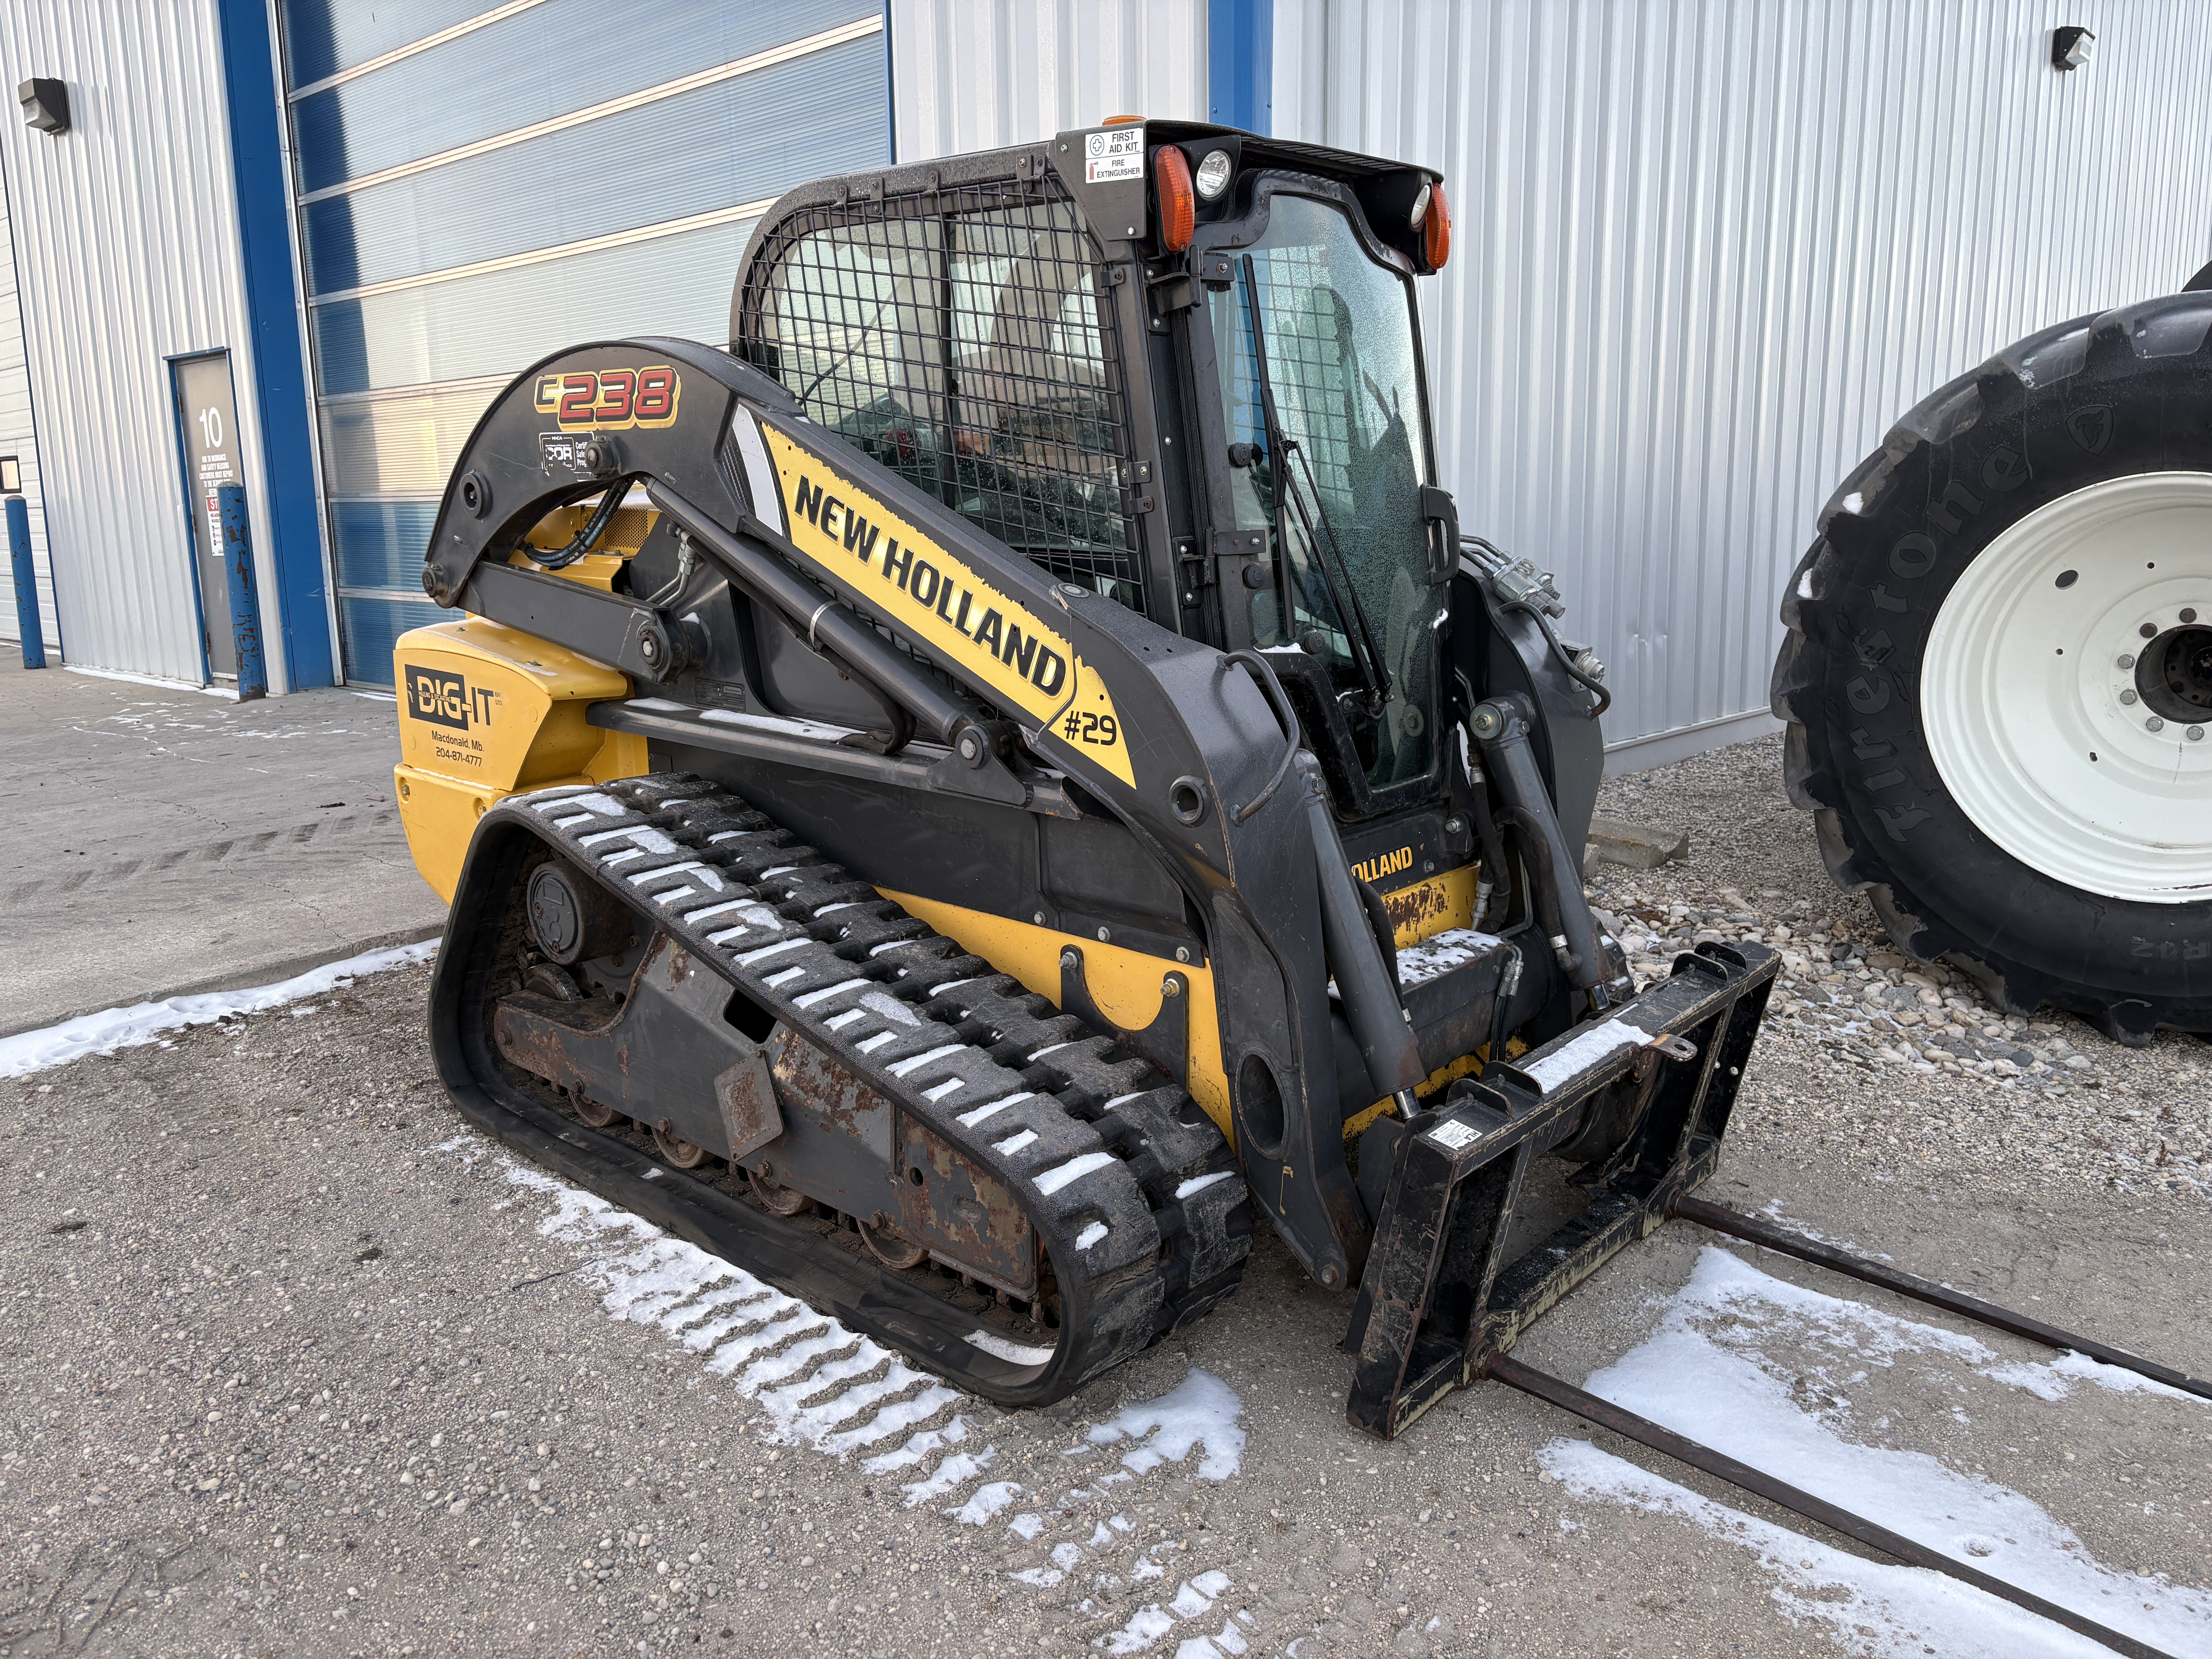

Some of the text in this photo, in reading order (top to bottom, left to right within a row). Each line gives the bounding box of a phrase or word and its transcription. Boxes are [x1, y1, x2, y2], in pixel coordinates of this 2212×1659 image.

[1109, 142, 1138, 153] AID KIT
[1112, 131, 1135, 143] FIRST
[1097, 167, 1140, 178] EXTINGUISHER
[199, 407, 223, 448] 10
[794, 475, 1066, 697] NEW HOLLAND
[1846, 444, 2032, 843] Firestone
[417, 675, 494, 726] DIG-IT
[1065, 711, 1117, 746] #29
[436, 747, 482, 767] 204-871-4777
[472, 739, 484, 752] Mb.
[1352, 846, 1413, 883] OLLAND
[1463, 1130, 1479, 1140] HLA
